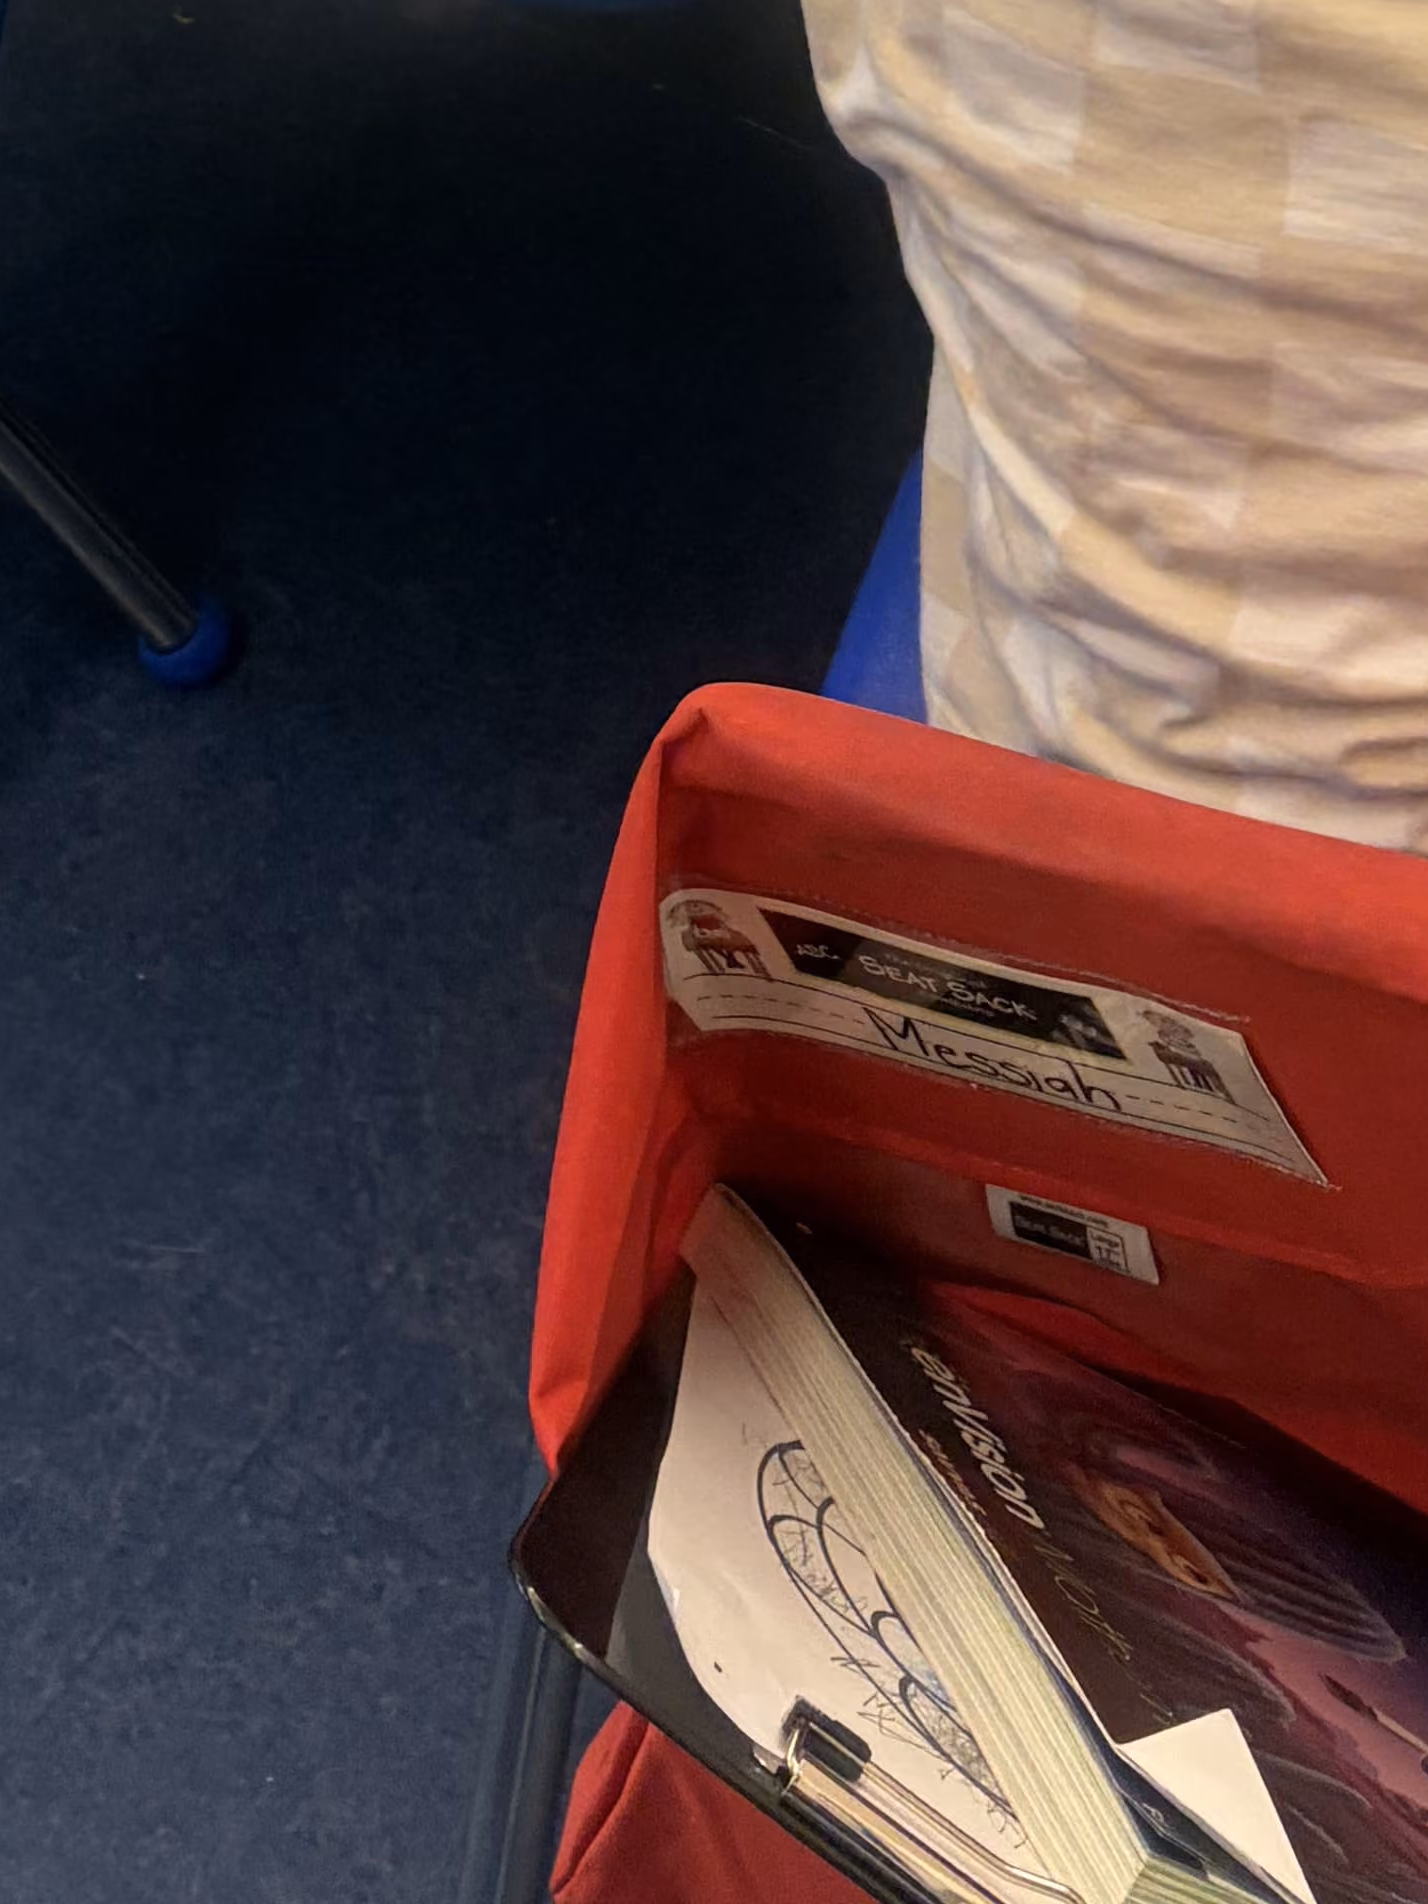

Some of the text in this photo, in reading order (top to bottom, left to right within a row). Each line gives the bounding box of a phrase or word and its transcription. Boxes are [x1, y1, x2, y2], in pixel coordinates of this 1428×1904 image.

[857, 954, 940, 994] SEAT
[947, 980, 1039, 1022] SACK
[862, 1006, 1124, 1114] Messiah
[910, 1346, 1045, 1531] enVision
